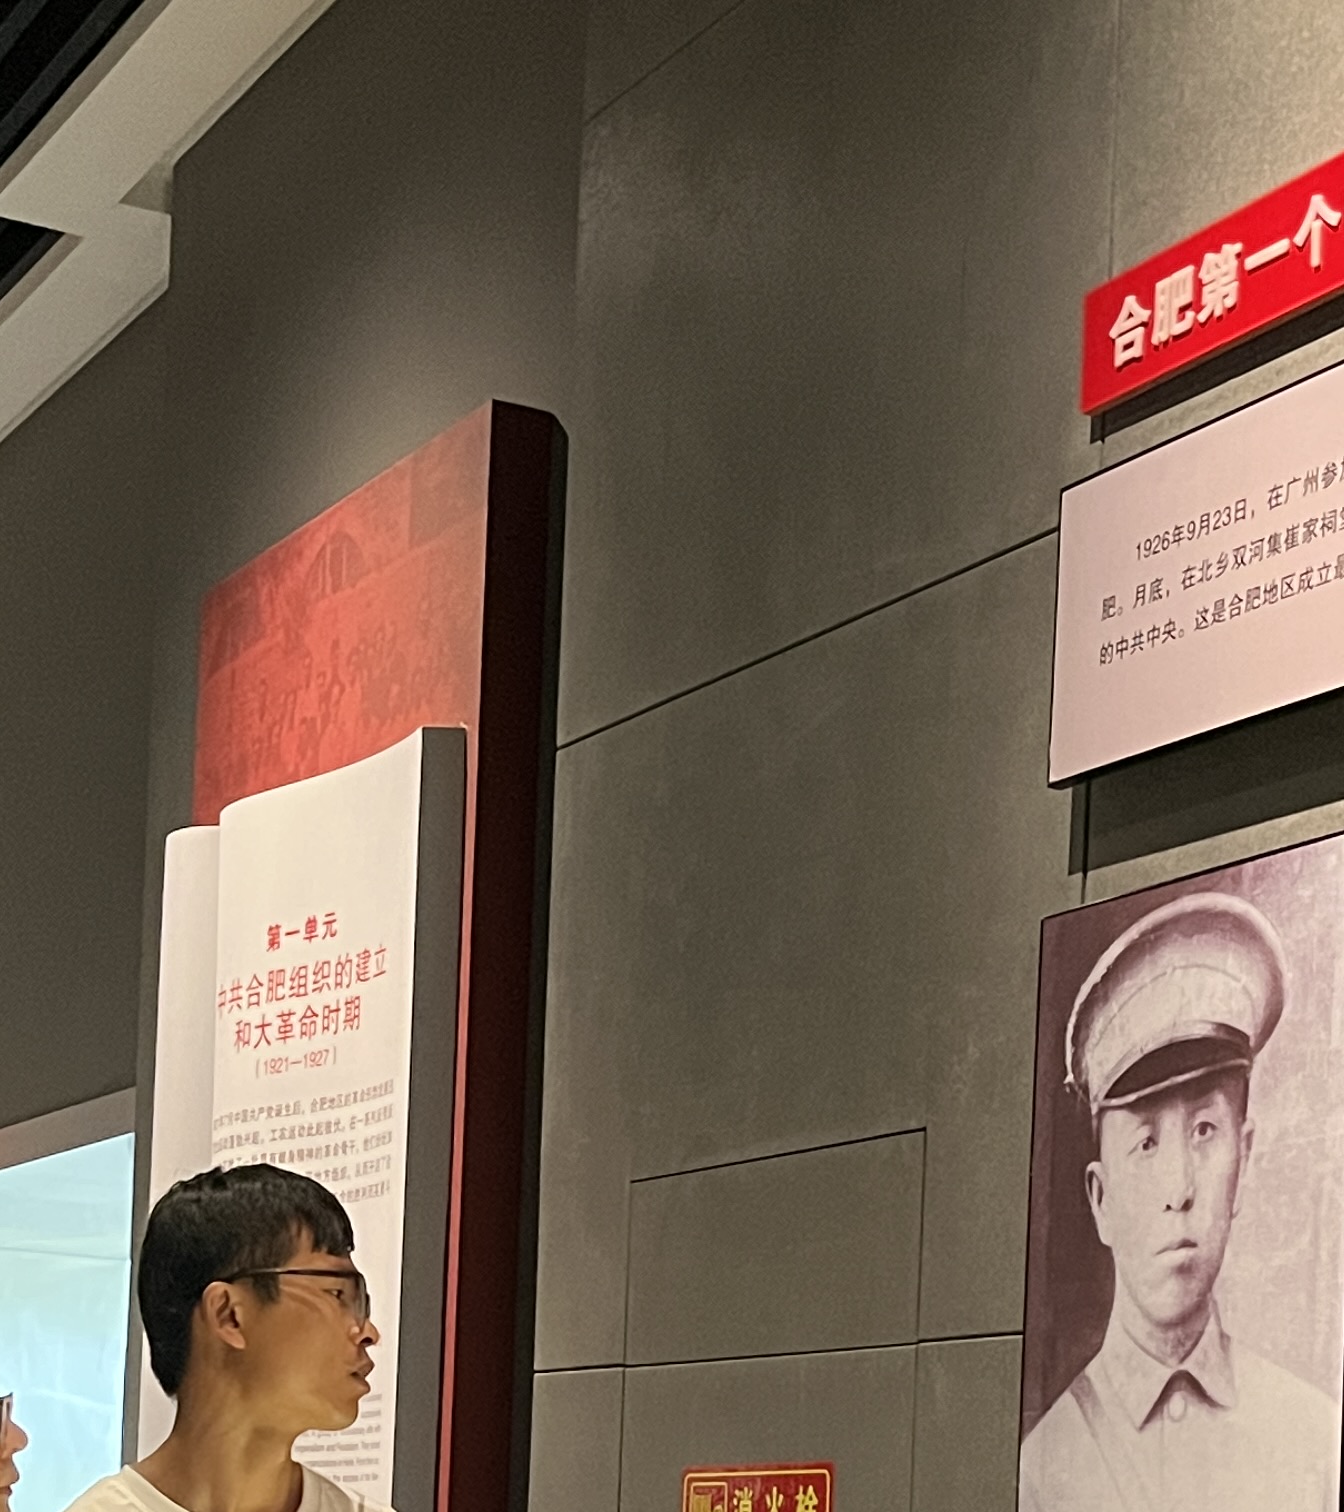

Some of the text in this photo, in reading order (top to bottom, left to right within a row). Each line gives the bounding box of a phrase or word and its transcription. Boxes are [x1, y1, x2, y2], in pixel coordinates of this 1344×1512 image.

[266, 911, 338, 953] 第一单元
[234, 995, 362, 1054] 和大革命时期
